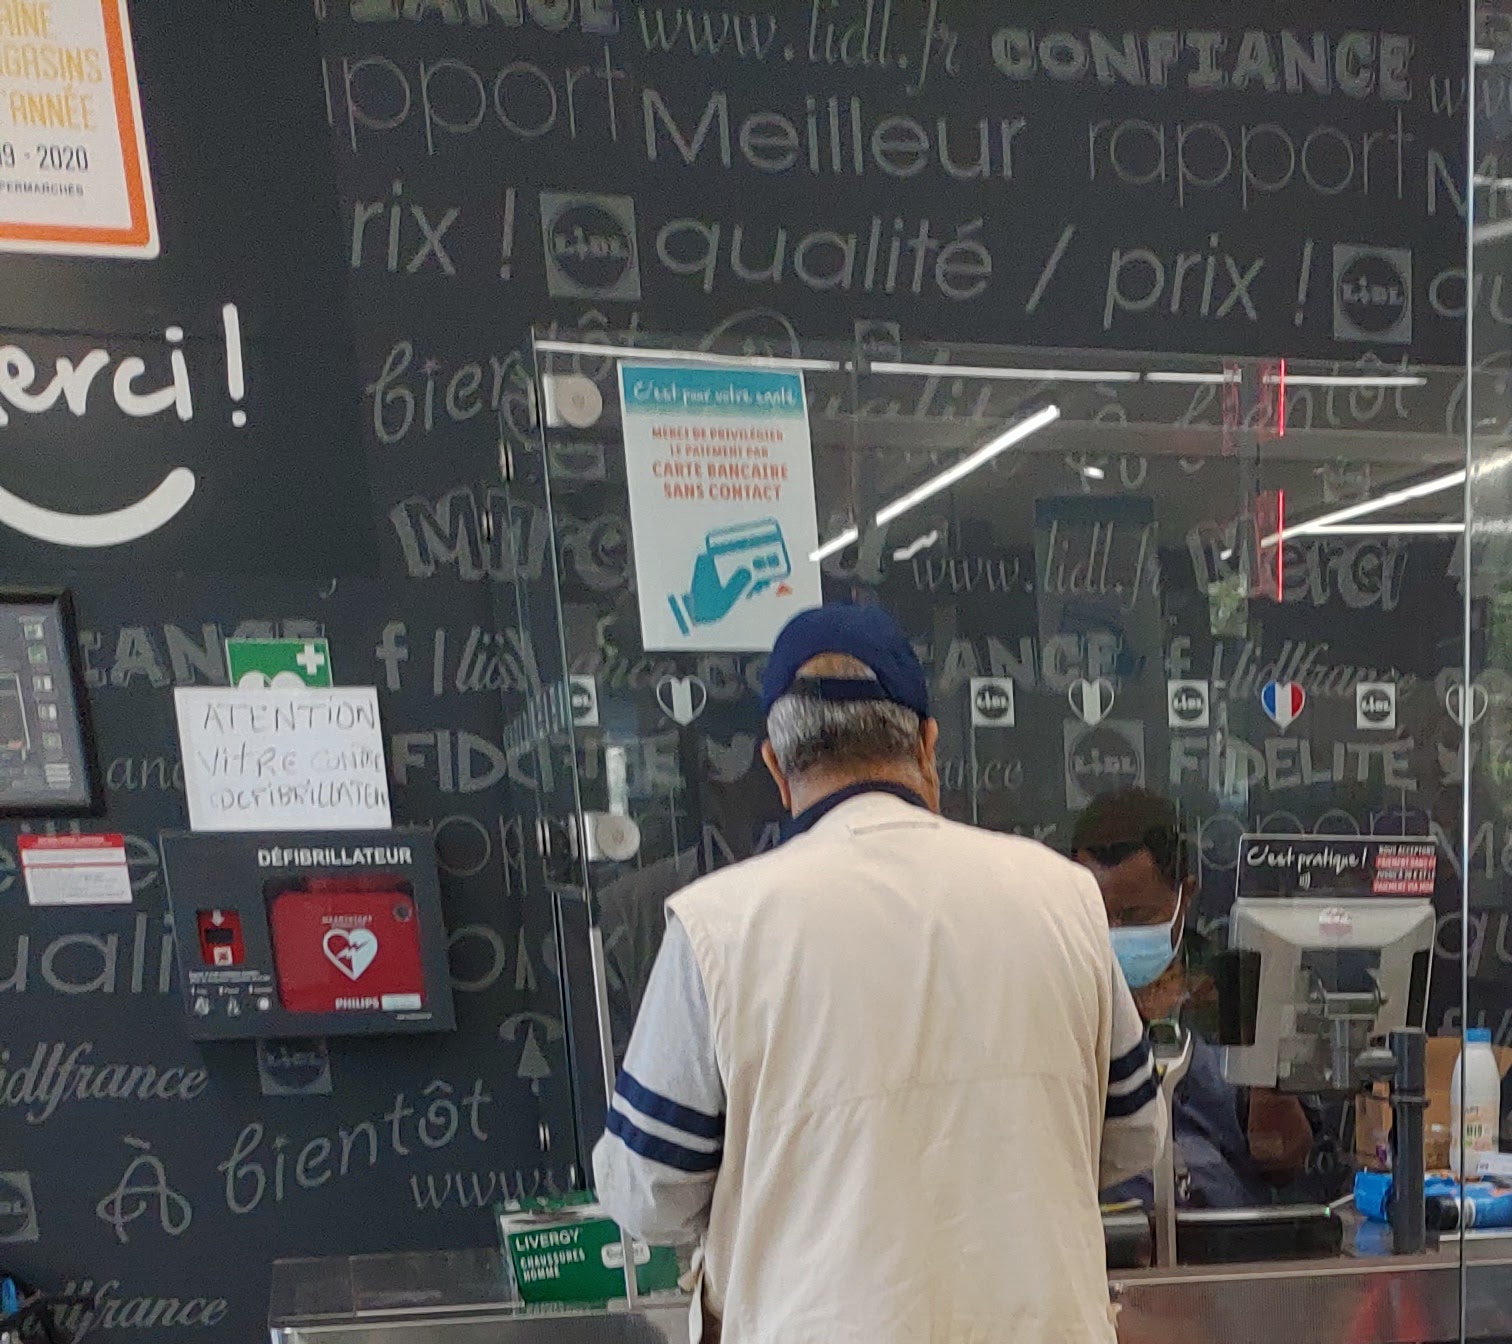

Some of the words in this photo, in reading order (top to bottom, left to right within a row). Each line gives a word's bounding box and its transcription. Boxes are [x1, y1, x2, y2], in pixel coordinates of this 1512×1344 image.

[991, 27, 1413, 101] CONFIANCE
[320, 42, 626, 156] pport
[641, 88, 1028, 180] Meilleur
[1087, 108, 1416, 210] rapport
[36, 144, 89, 173] 2020
[655, 215, 993, 299] qualité
[1102, 231, 1266, 331] prix
[652, 461, 703, 478] CARTE
[707, 463, 789, 480] BANCAIRE
[664, 482, 705, 499] SANS
[709, 483, 783, 500] CONTACT
[257, 845, 413, 868] DÉFIBRILLATEUR
[1246, 844, 1294, 868] C'est
[1297, 845, 1359, 876] pratique
[335, 996, 380, 1010] PHILIPS
[96, 1133, 193, 1244] À
[216, 1077, 492, 1214] bientôt
[515, 1227, 581, 1252] LIVERGY
[519, 1247, 586, 1271] CHAUSSURES
[523, 1265, 561, 1284] HOMME
